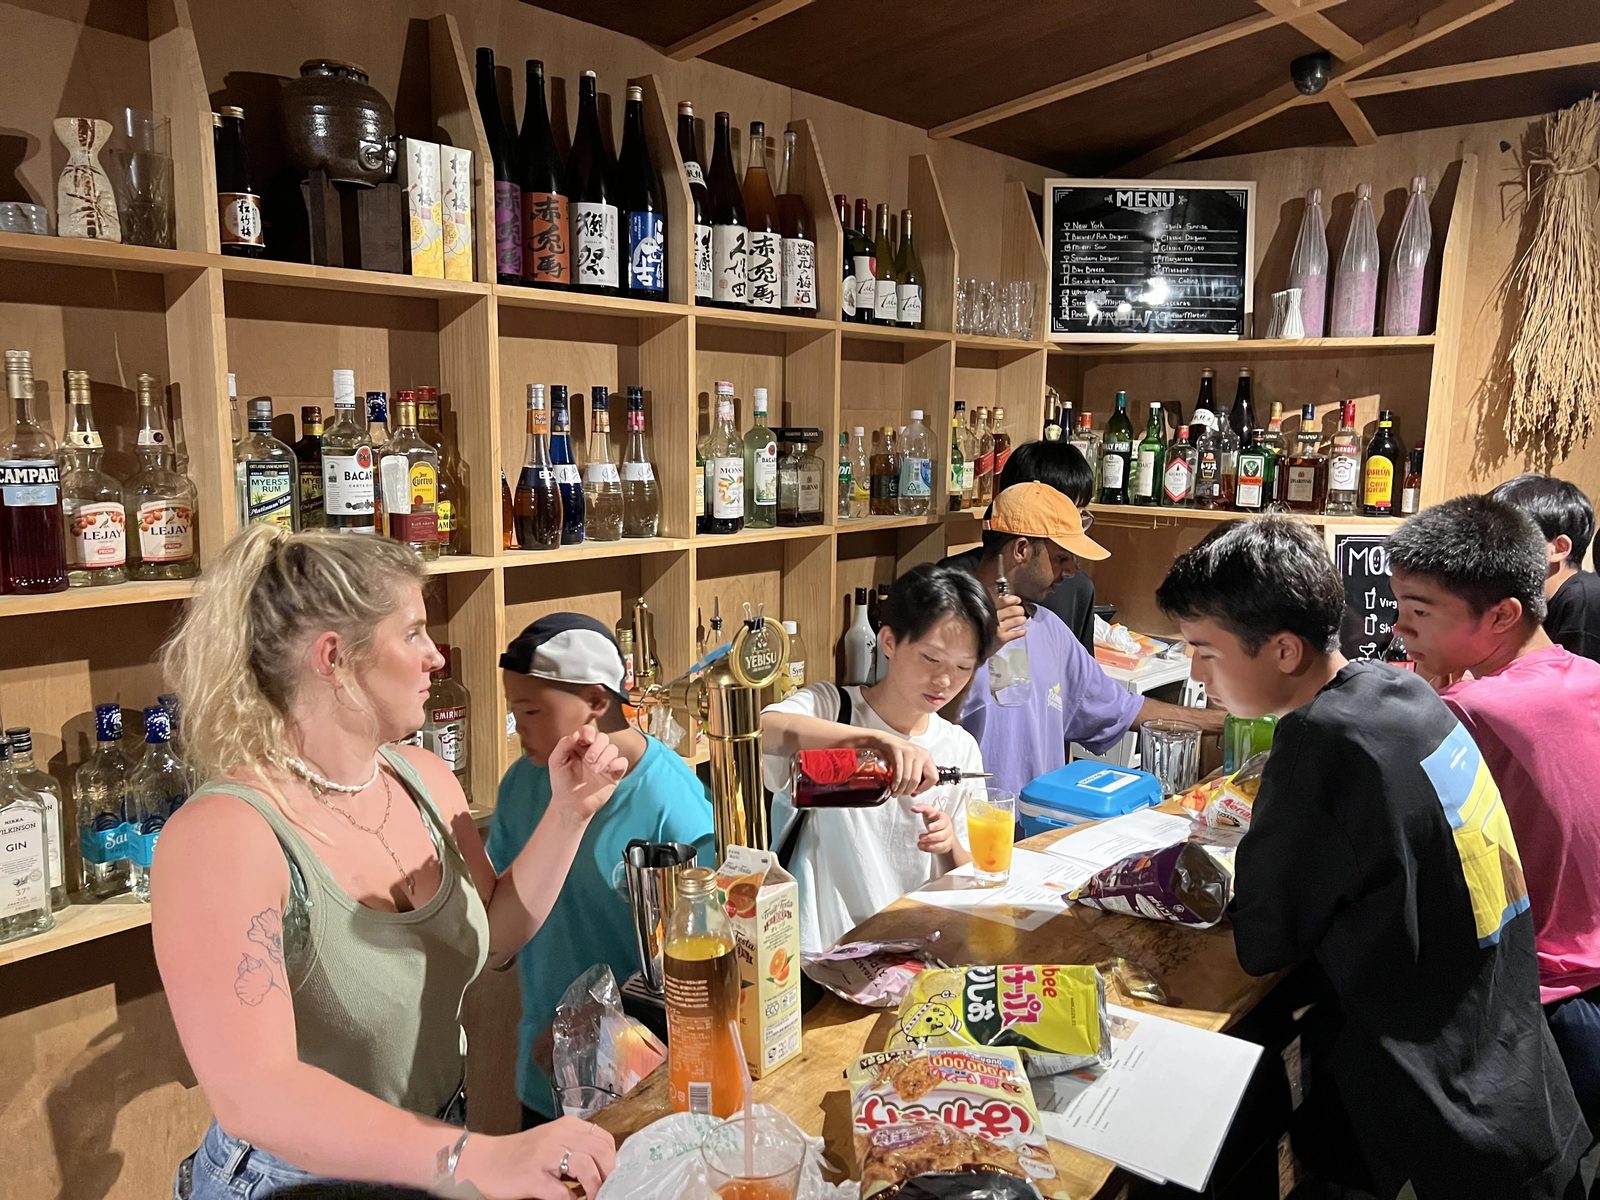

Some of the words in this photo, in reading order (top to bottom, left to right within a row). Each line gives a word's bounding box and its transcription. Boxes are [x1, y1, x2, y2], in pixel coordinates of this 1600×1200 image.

[415, 146, 434, 207] 松竹梅
[450, 152, 468, 211] 松竹梅
[1116, 191, 1175, 207] MENU
[238, 199, 252, 238] 松竹梅
[1072, 221, 1088, 229] New
[1090, 220, 1104, 229] York
[576, 211, 609, 276] 獺祭
[1184, 244, 1205, 252] Mojito
[1200, 462, 1217, 470] トリス
[0, 467, 60, 484] CAMPARI
[84, 531, 122, 541] LEJAY
[151, 524, 189, 535] LEJAY
[745, 651, 777, 669] YEBISU
[0, 822, 36, 836] ILKINSON
[6, 841, 27, 852] GIN
[1041, 965, 1061, 998] bee
